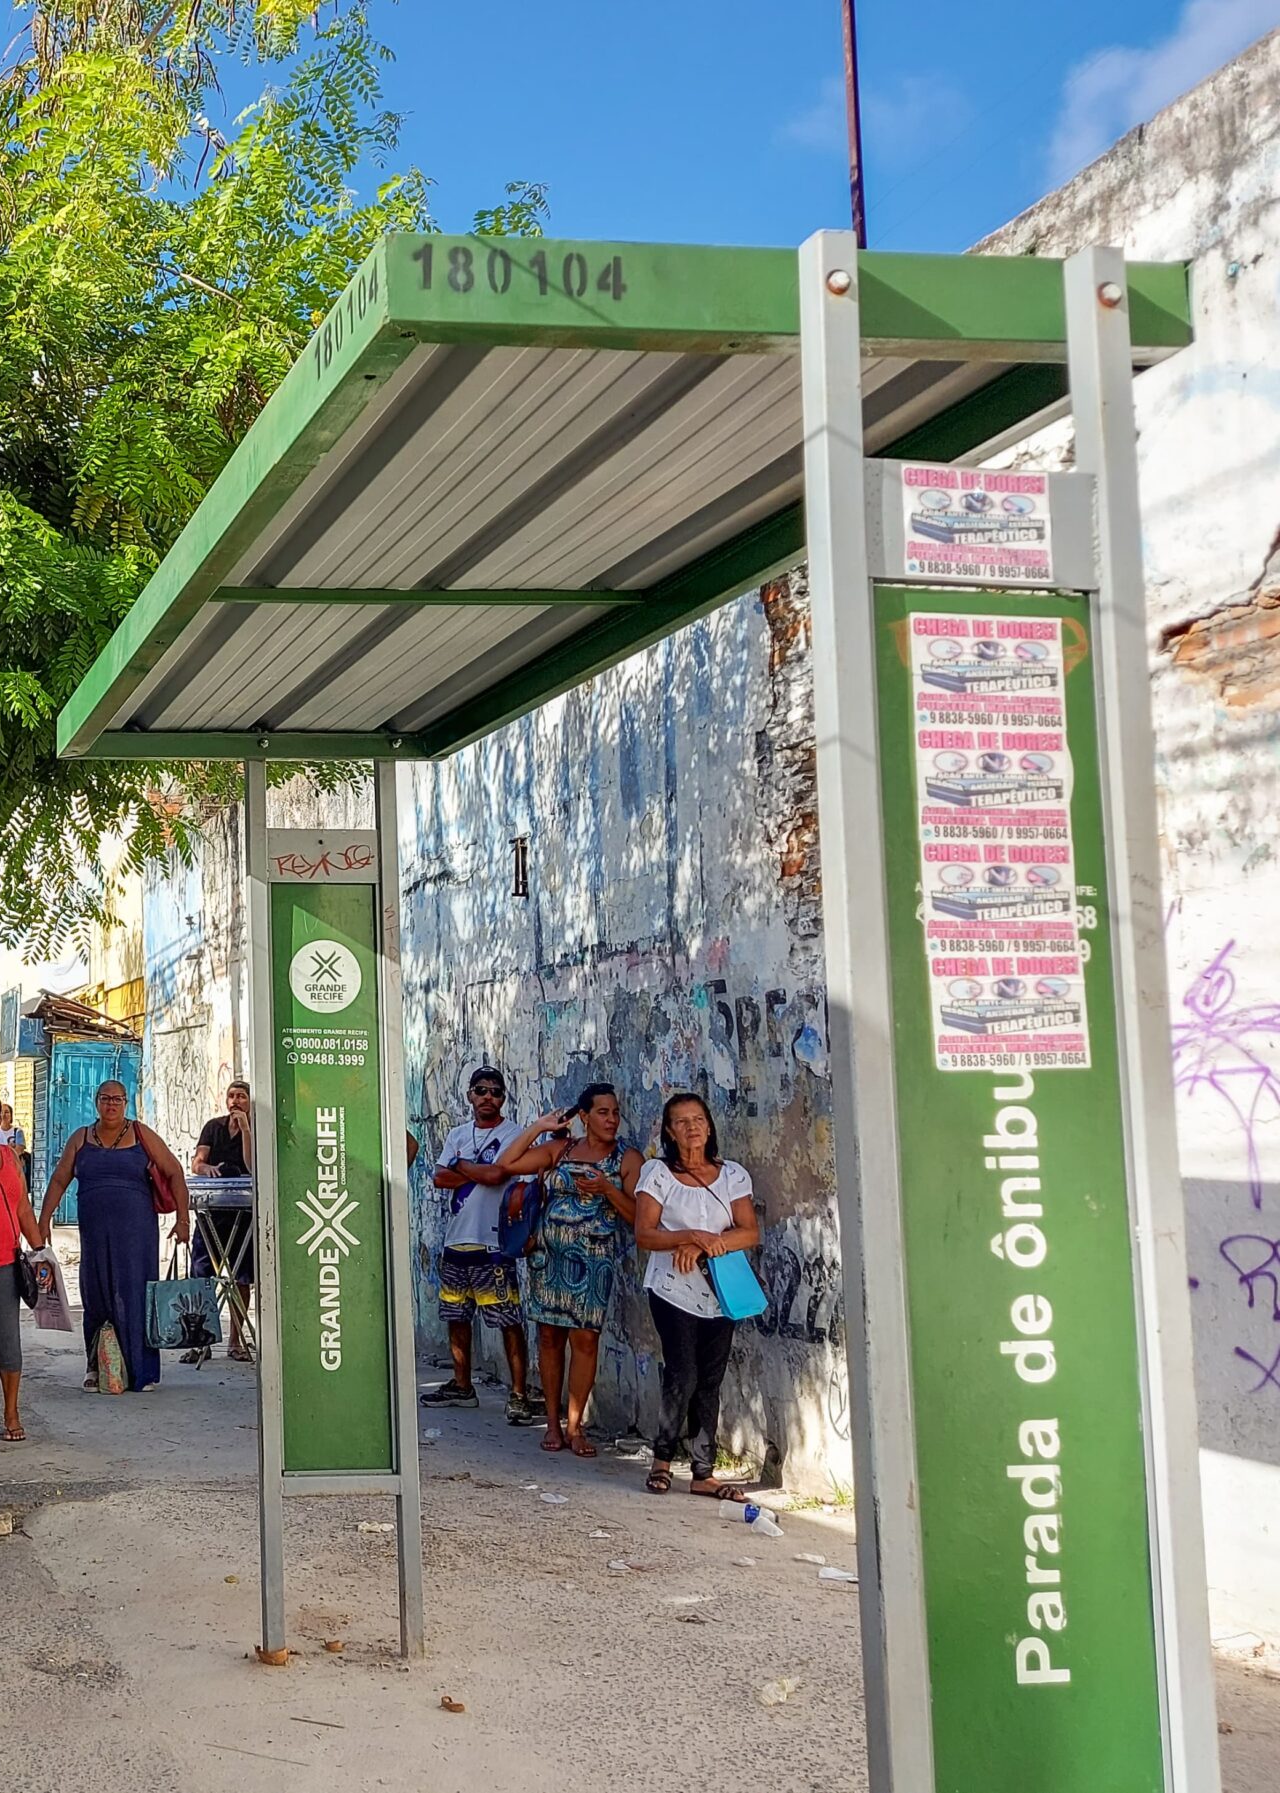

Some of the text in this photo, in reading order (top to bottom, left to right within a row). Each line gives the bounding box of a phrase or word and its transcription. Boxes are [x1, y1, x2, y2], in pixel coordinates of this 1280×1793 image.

[412, 242, 627, 301] 180104
[314, 257, 379, 381] 180104
[904, 467, 958, 488] CHEGA
[961, 471, 982, 490] DE
[919, 561, 926, 574] 9
[928, 561, 981, 576] 8838-5960
[990, 565, 996, 577] 9
[998, 565, 1050, 579] 9957-0664
[913, 617, 970, 637] CHEGA
[973, 619, 994, 638] DE
[930, 711, 936, 724] 9
[939, 711, 993, 725] 8838-5960
[1003, 714, 1009, 726] 9
[1011, 714, 1063, 727] 9957-0664
[918, 730, 975, 750] CHEGA
[978, 731, 1000, 750] DE
[970, 786, 1057, 808] TERAPÊUTICO
[934, 825, 940, 838] 9
[943, 825, 997, 839] 8838-5960
[1007, 827, 1014, 839] 9
[1016, 827, 1068, 840] 9957-0664
[924, 843, 981, 863] CHEGA
[983, 844, 1006, 863] DE
[975, 900, 1064, 921] TERAPÊUTICO
[940, 940, 947, 952] 9
[949, 940, 1004, 952] 8838-5960
[1014, 940, 1020, 952] 9
[1022, 940, 1075, 952] 9957-0664
[932, 957, 989, 976] CHEGA
[992, 957, 1014, 976] DE
[304, 984, 347, 992] GRANDE
[310, 992, 343, 1000] RECIFE
[986, 1012, 1074, 1034] TERAPÊUTICO
[296, 1037, 368, 1051] 0800.081.0158
[300, 1053, 365, 1066] 99488.3999
[951, 1054, 958, 1067] 9
[960, 1053, 1016, 1067] 8838-5960
[1025, 1053, 1032, 1066] 9
[1034, 1052, 1087, 1065] 9957-0664
[983, 1069, 1047, 1268] ônibu
[316, 1106, 342, 1371] GRANDE RECIFE
[1000, 1294, 1056, 1383] de
[1006, 1417, 1072, 1685] Parada
